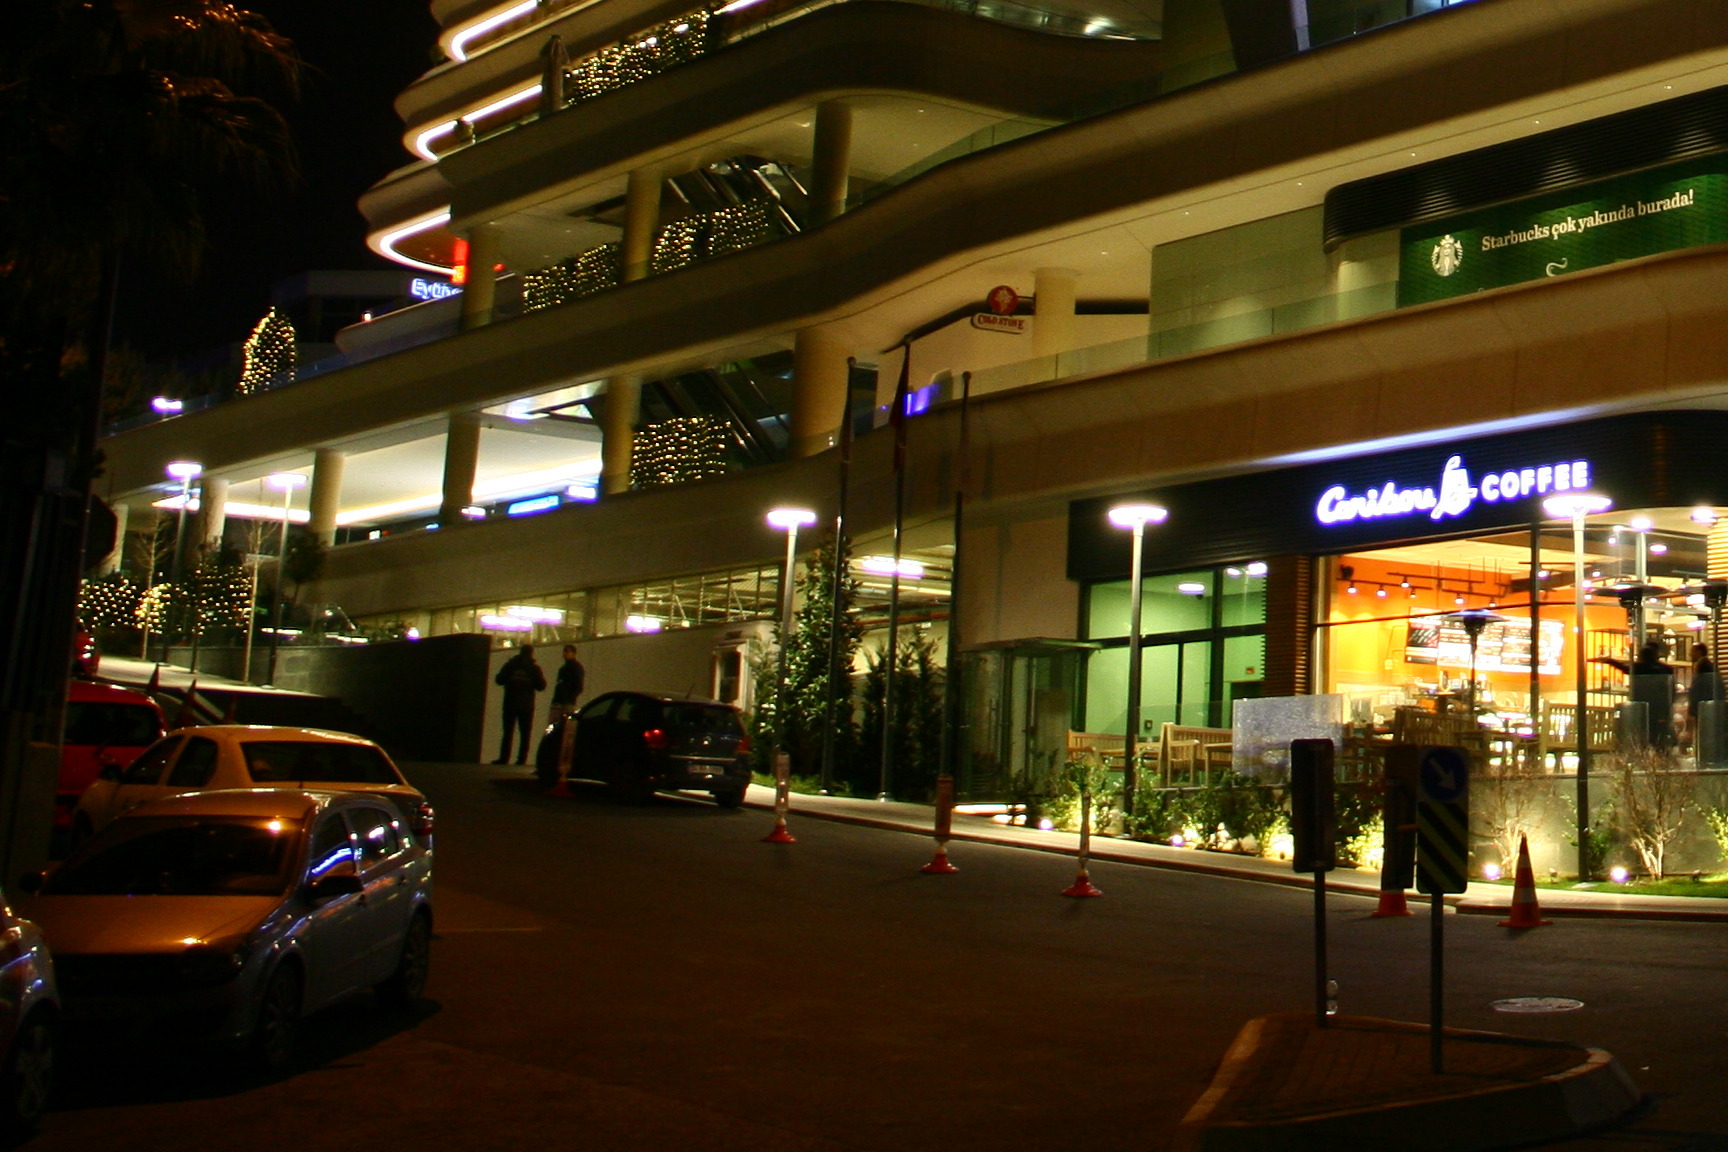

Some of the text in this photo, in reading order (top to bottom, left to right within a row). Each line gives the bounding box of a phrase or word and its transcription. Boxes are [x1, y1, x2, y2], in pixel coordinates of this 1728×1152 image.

[1481, 188, 1694, 251] Starbucks çok yakında burada!
[1315, 459, 1589, 524] Caribou COFFEE
